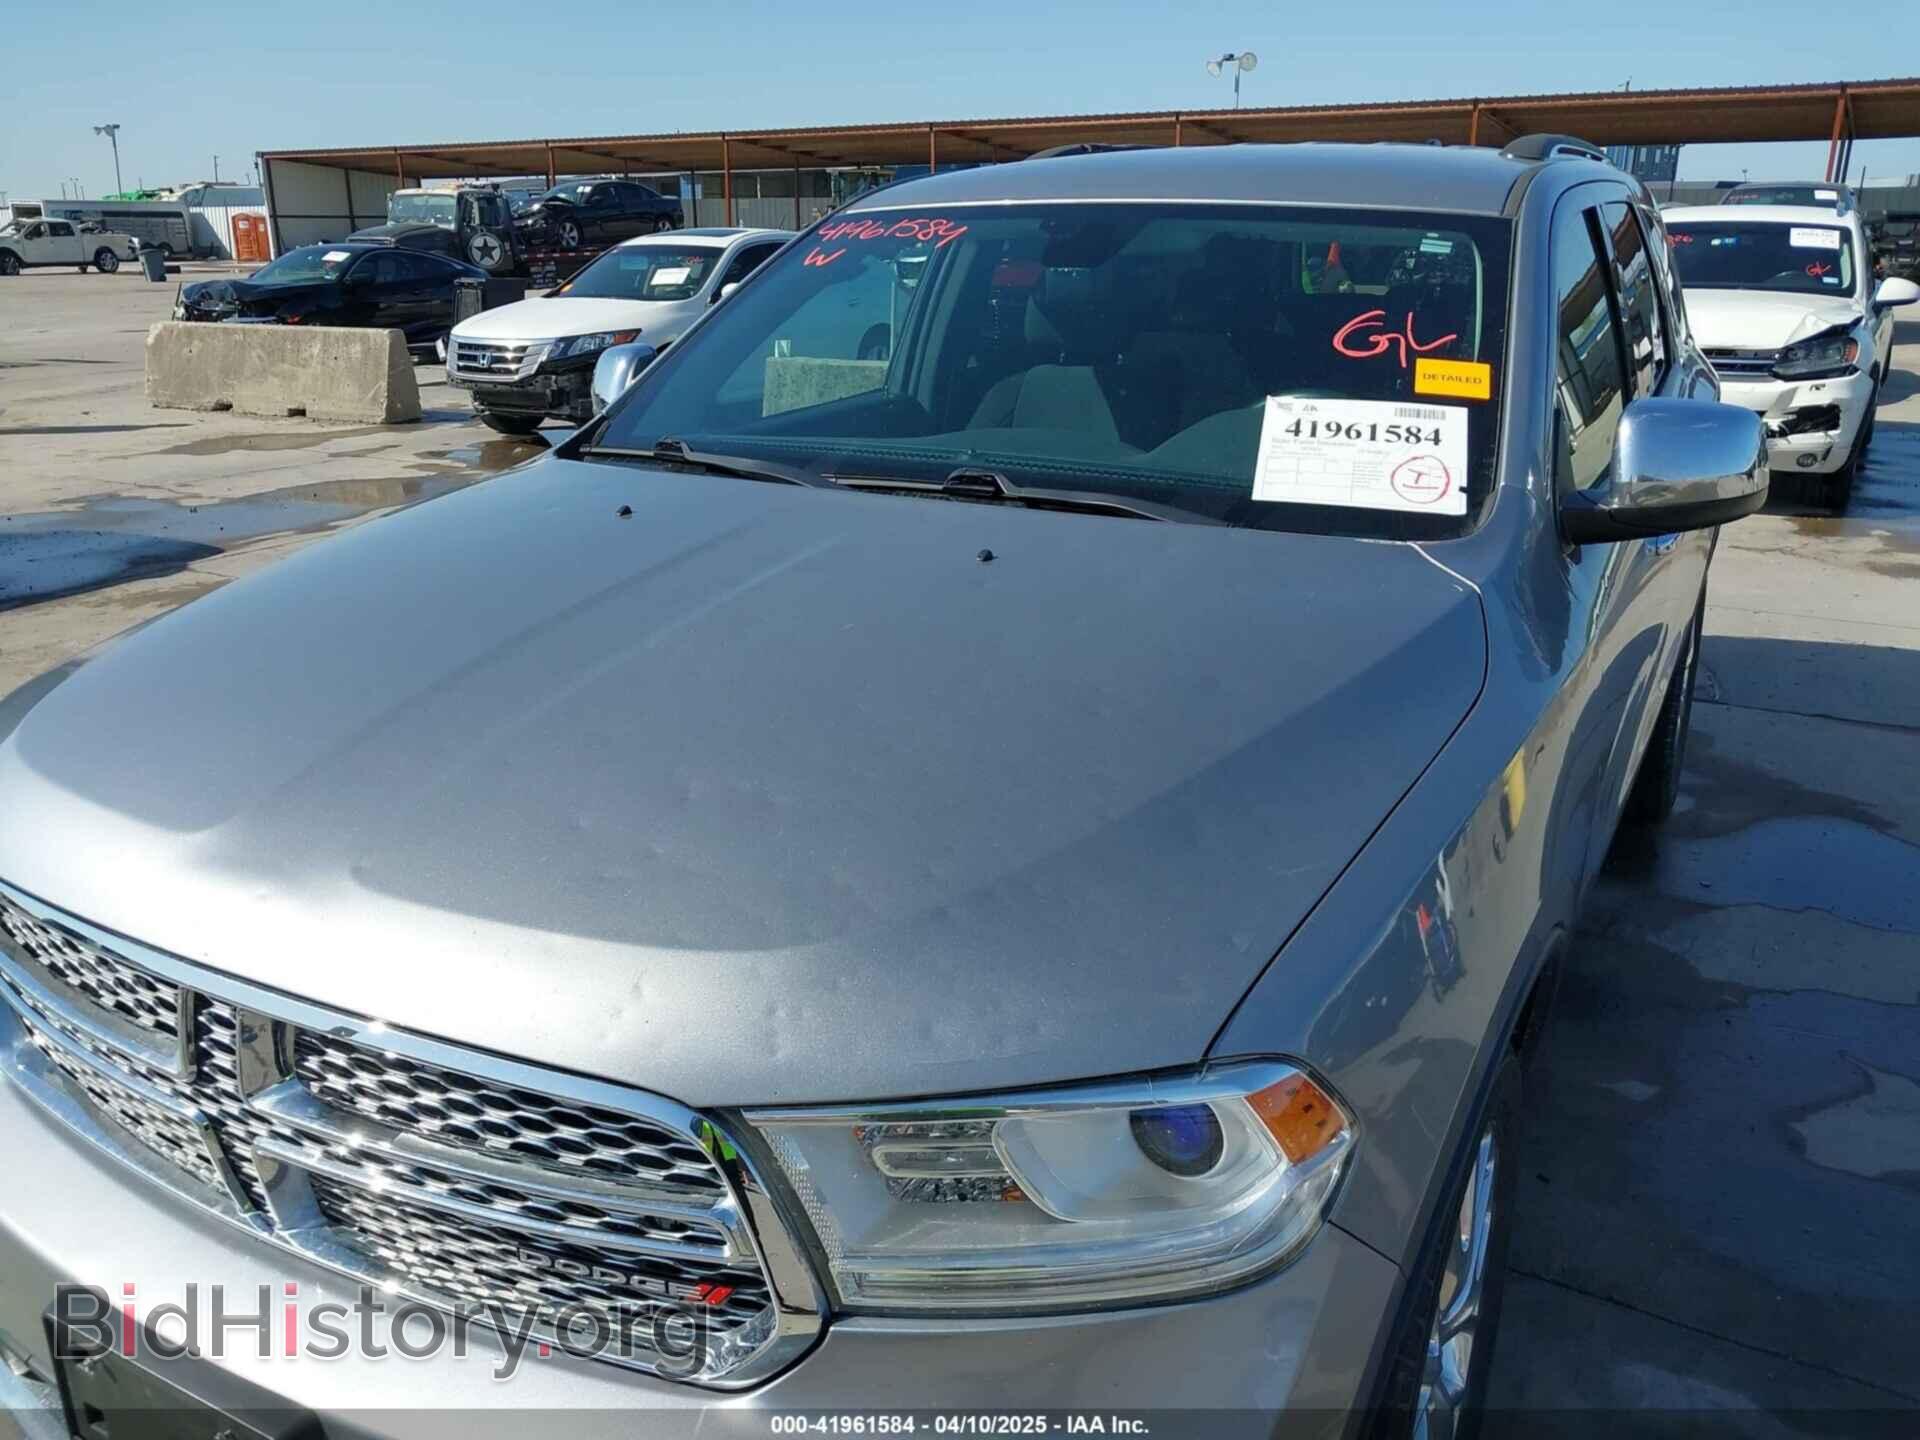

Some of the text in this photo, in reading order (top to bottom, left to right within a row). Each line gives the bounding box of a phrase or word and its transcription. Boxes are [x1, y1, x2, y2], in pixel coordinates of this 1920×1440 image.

[1422, 372, 1482, 385] DETAILED
[1285, 418, 1442, 446] 41961584
[518, 1248, 702, 1301] DODGE
